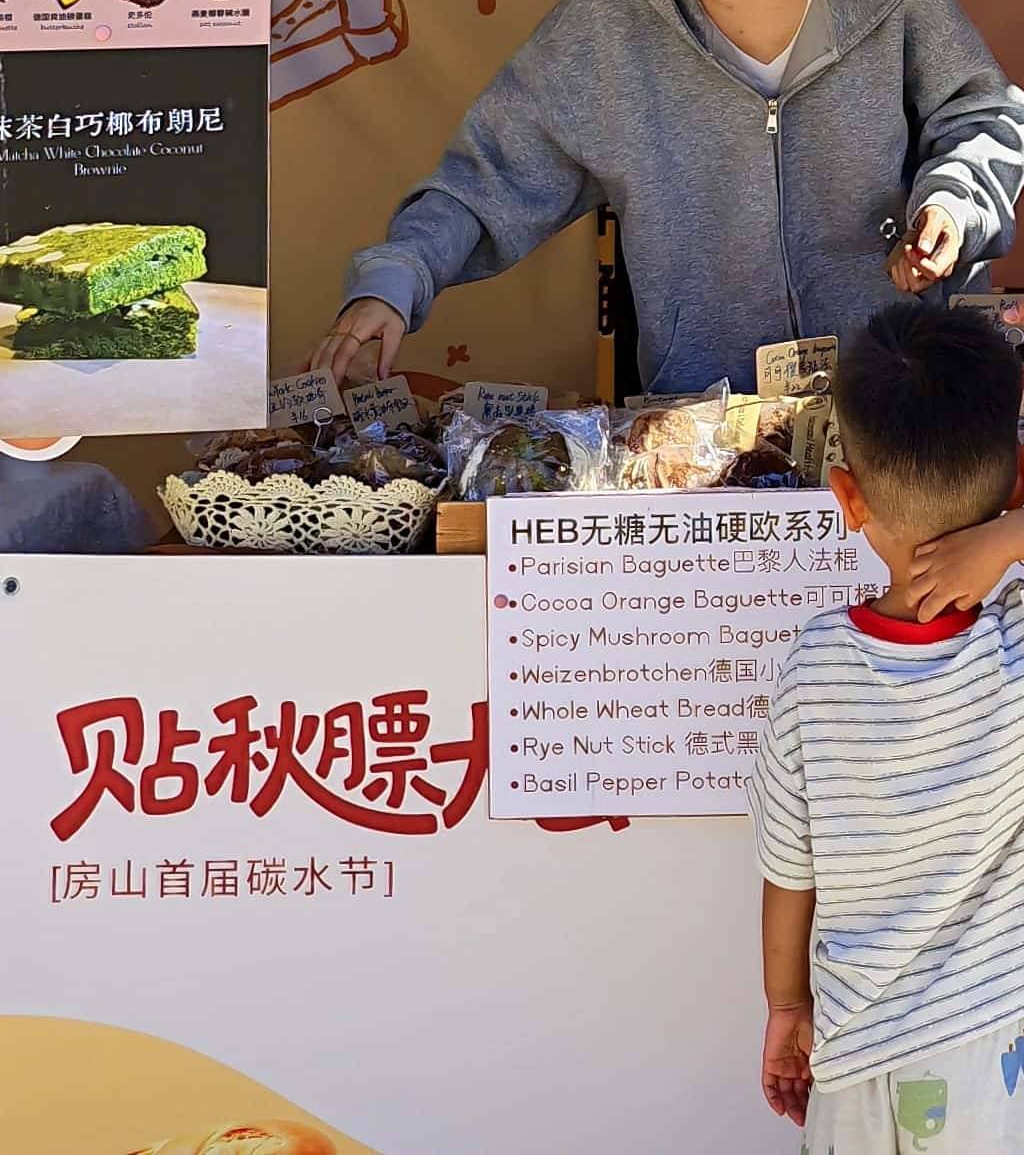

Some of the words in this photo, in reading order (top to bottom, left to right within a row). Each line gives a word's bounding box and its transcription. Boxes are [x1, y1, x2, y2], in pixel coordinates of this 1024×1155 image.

[44, 145, 82, 160] White
[85, 144, 147, 160] Chocolate
[150, 142, 204, 156] Coconut
[74, 162, 128, 177] Brownie
[510, 509, 848, 547] HEB无糖无油硬欧系列
[521, 555, 614, 576] Parisian
[622, 547, 859, 579] Baguette巴黎人法棍
[520, 593, 593, 613] Cocoa
[602, 591, 686, 618] Orange
[693, 583, 892, 615] Baguette可可橙
[521, 628, 580, 653] Spicy
[589, 625, 711, 648] Mushroom
[719, 624, 801, 649] Baguet
[521, 699, 588, 721] Whole
[596, 697, 670, 720] Wheat
[522, 736, 564, 761] Rye
[573, 735, 613, 755] Nut
[621, 733, 676, 755] Stick
[684, 730, 760, 756] 德式黑
[522, 771, 578, 794] Basil
[586, 769, 667, 796] Pepper
[49, 855, 396, 902] [房山首届碳水节]
